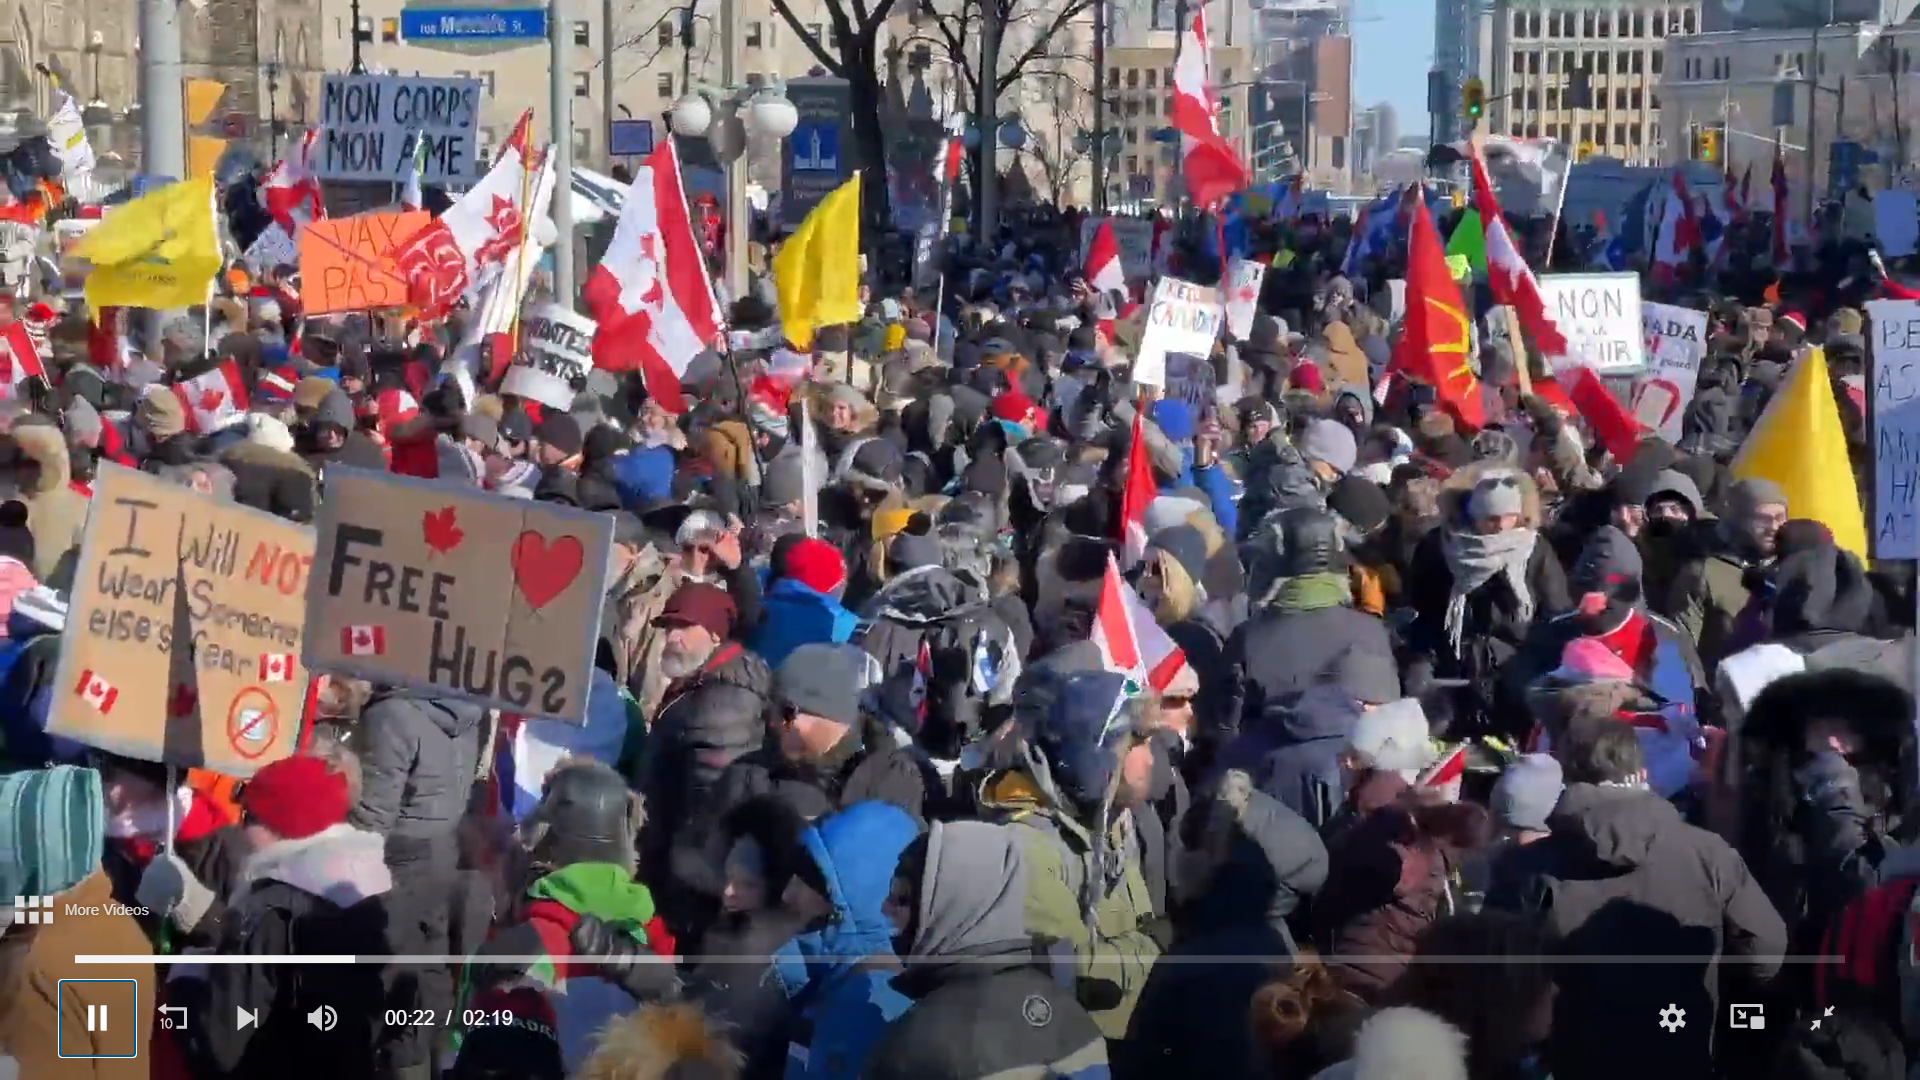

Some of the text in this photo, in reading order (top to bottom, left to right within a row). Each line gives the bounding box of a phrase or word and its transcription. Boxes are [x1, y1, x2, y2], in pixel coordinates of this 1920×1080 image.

[325, 82, 474, 128] MON CORPS
[326, 128, 384, 172] MON
[1557, 288, 1623, 319] NON
[109, 497, 158, 557] I
[176, 512, 240, 577] Will
[327, 521, 456, 620] FREE
[98, 560, 299, 646] Wear Someone
[189, 629, 252, 677] fear
